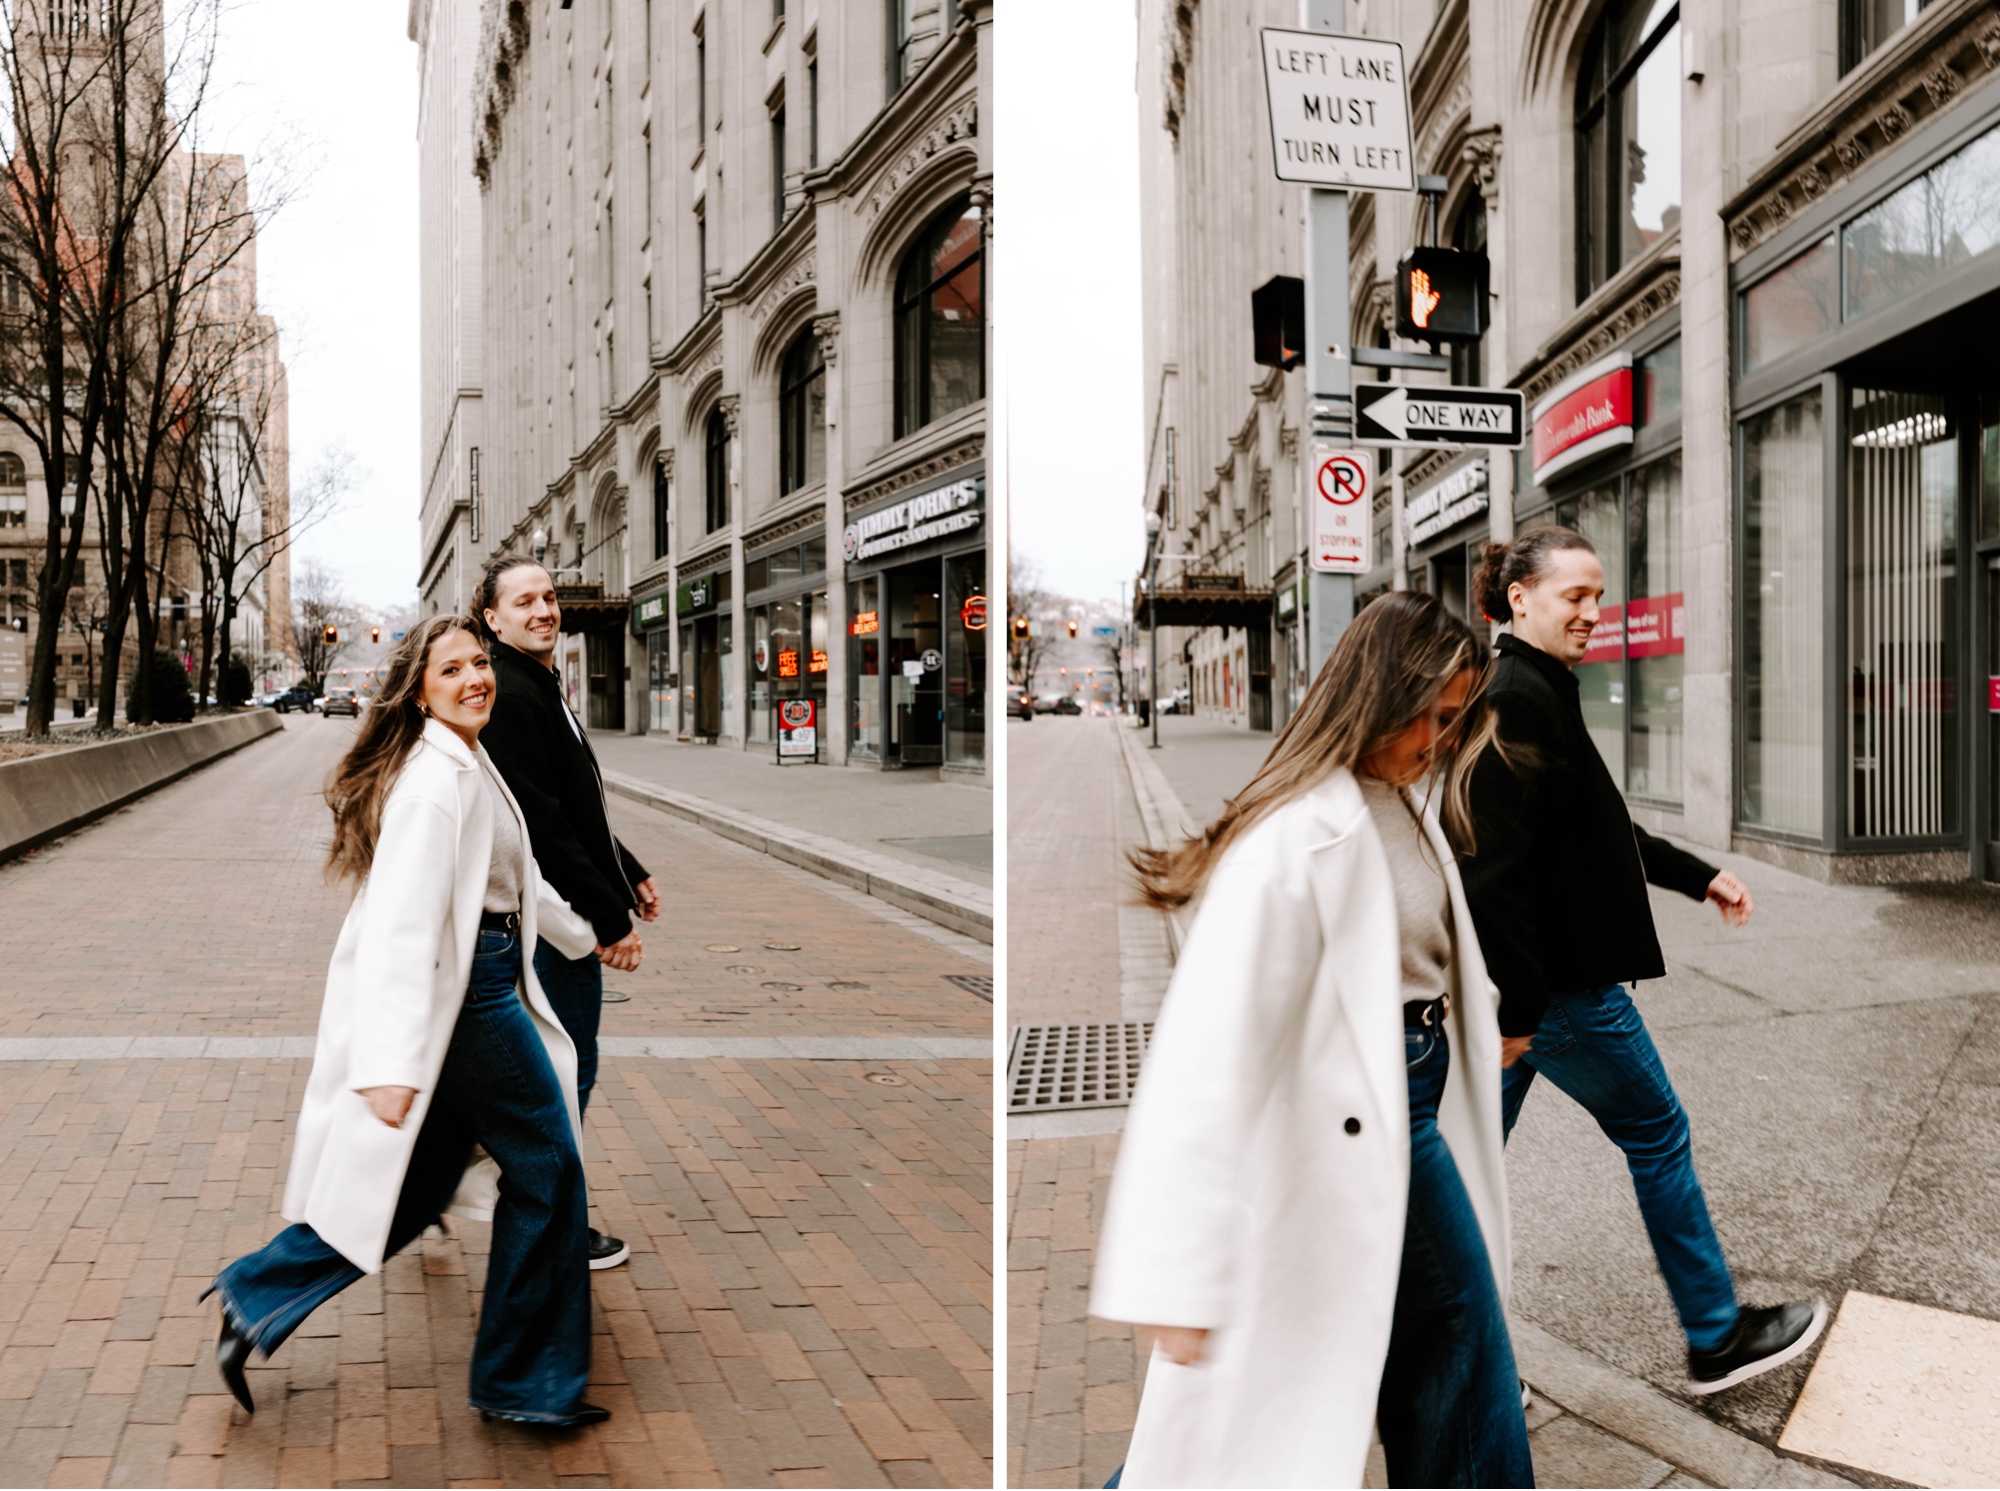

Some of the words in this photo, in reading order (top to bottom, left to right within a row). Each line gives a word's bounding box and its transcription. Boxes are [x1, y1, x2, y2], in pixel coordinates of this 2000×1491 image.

[1275, 48, 1329, 76] LEFT
[1340, 55, 1397, 84] LANE
[1303, 93, 1377, 127] MUST
[1283, 139, 1341, 166] TURN
[1354, 145, 1404, 172] LEFT
[1406, 404, 1451, 427] ONE
[1459, 407, 1505, 429] WAY
[858, 503, 907, 546] JIMMY
[907, 480, 974, 530] JOHN'S
[1335, 515, 1348, 528] OR
[1319, 534, 1363, 549] STOPPING
[778, 651, 798, 666] FREE
